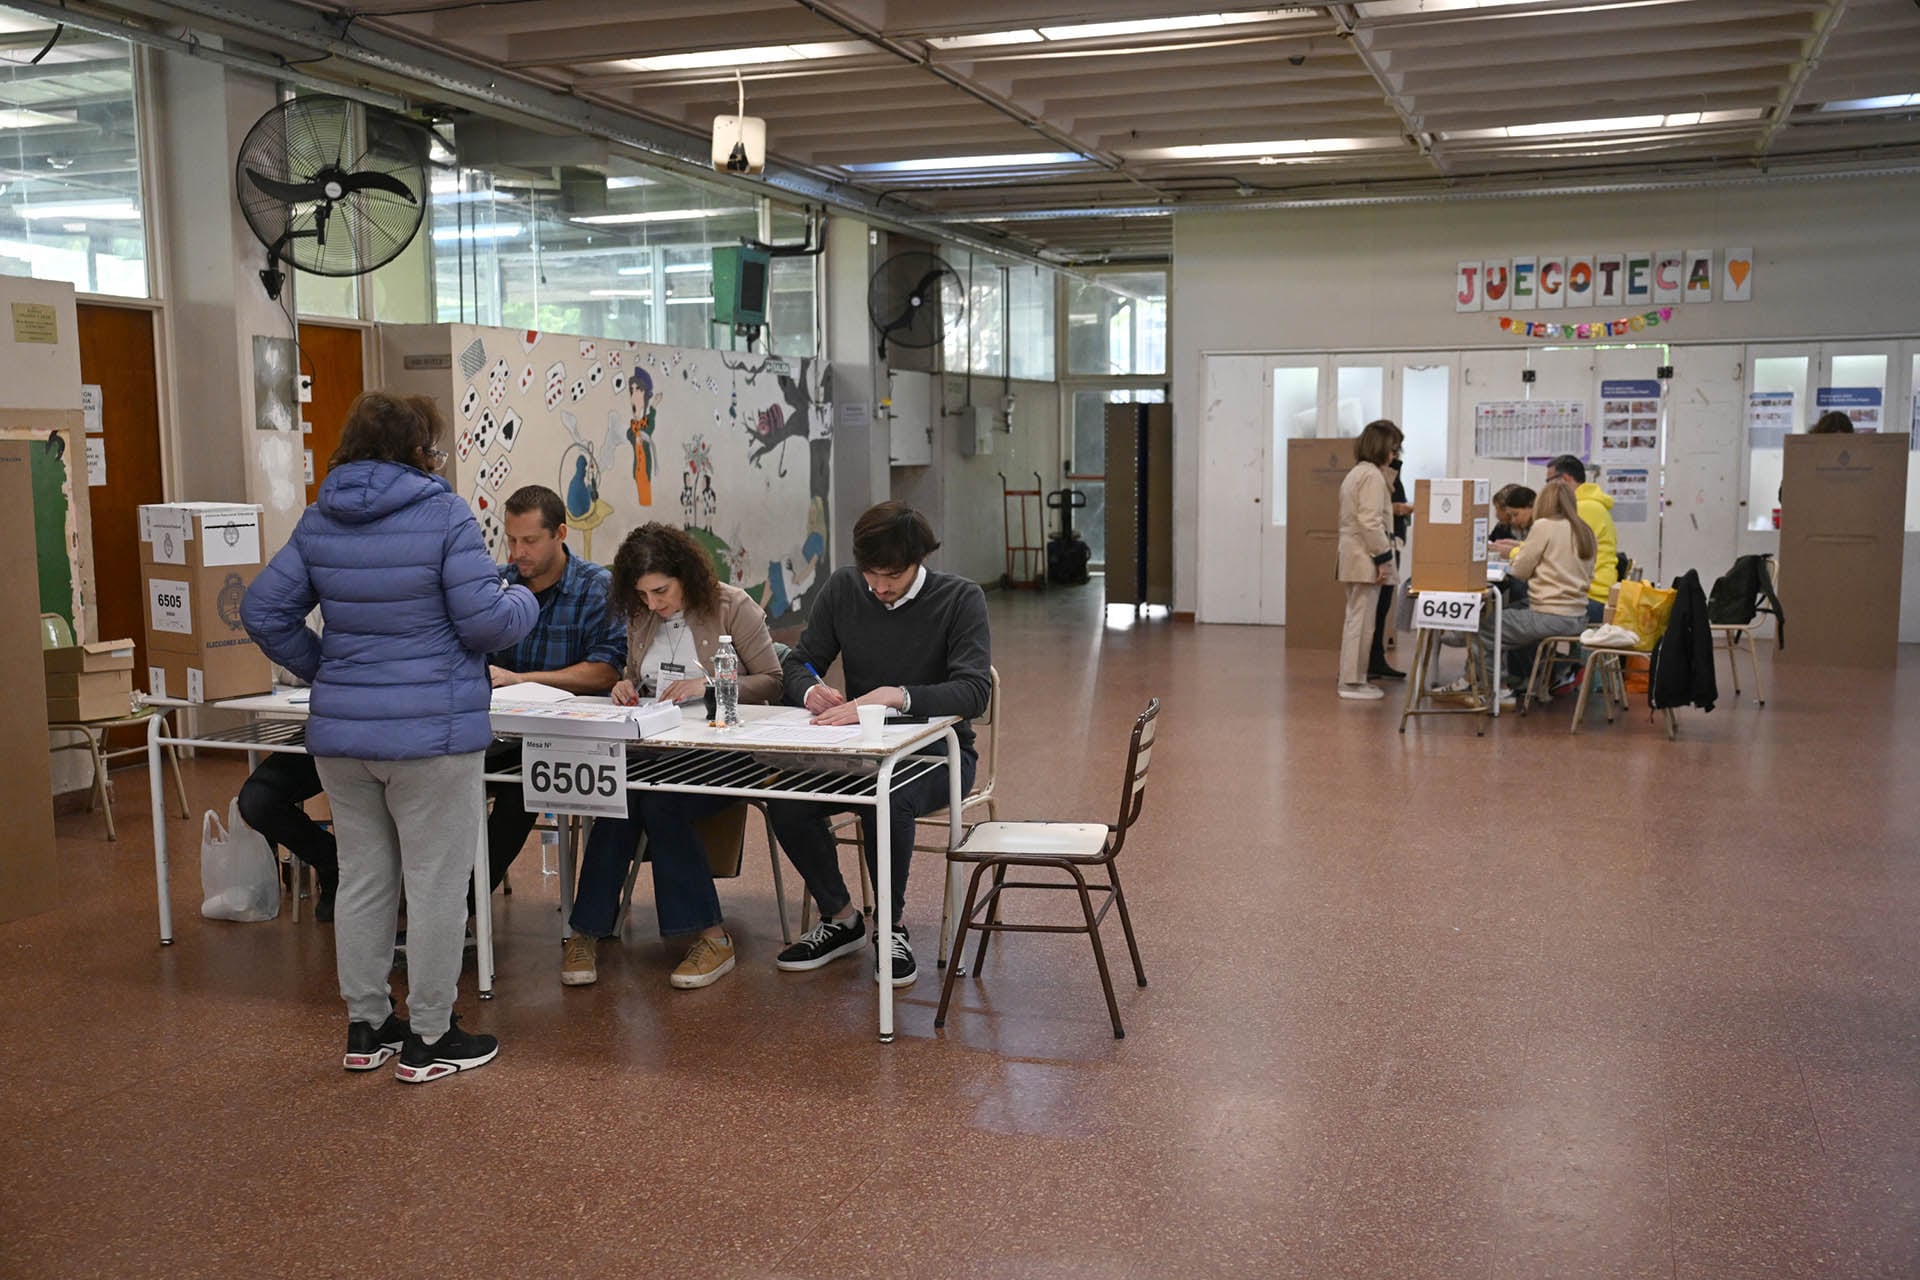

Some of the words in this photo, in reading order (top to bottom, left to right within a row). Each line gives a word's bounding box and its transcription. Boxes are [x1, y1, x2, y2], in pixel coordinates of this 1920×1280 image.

[1458, 259, 1711, 304] JUEGOTECA
[158, 594, 182, 608] 6505
[1423, 600, 1475, 620] 6497
[526, 740, 544, 749] Mesa
[531, 760, 617, 797] 6505
